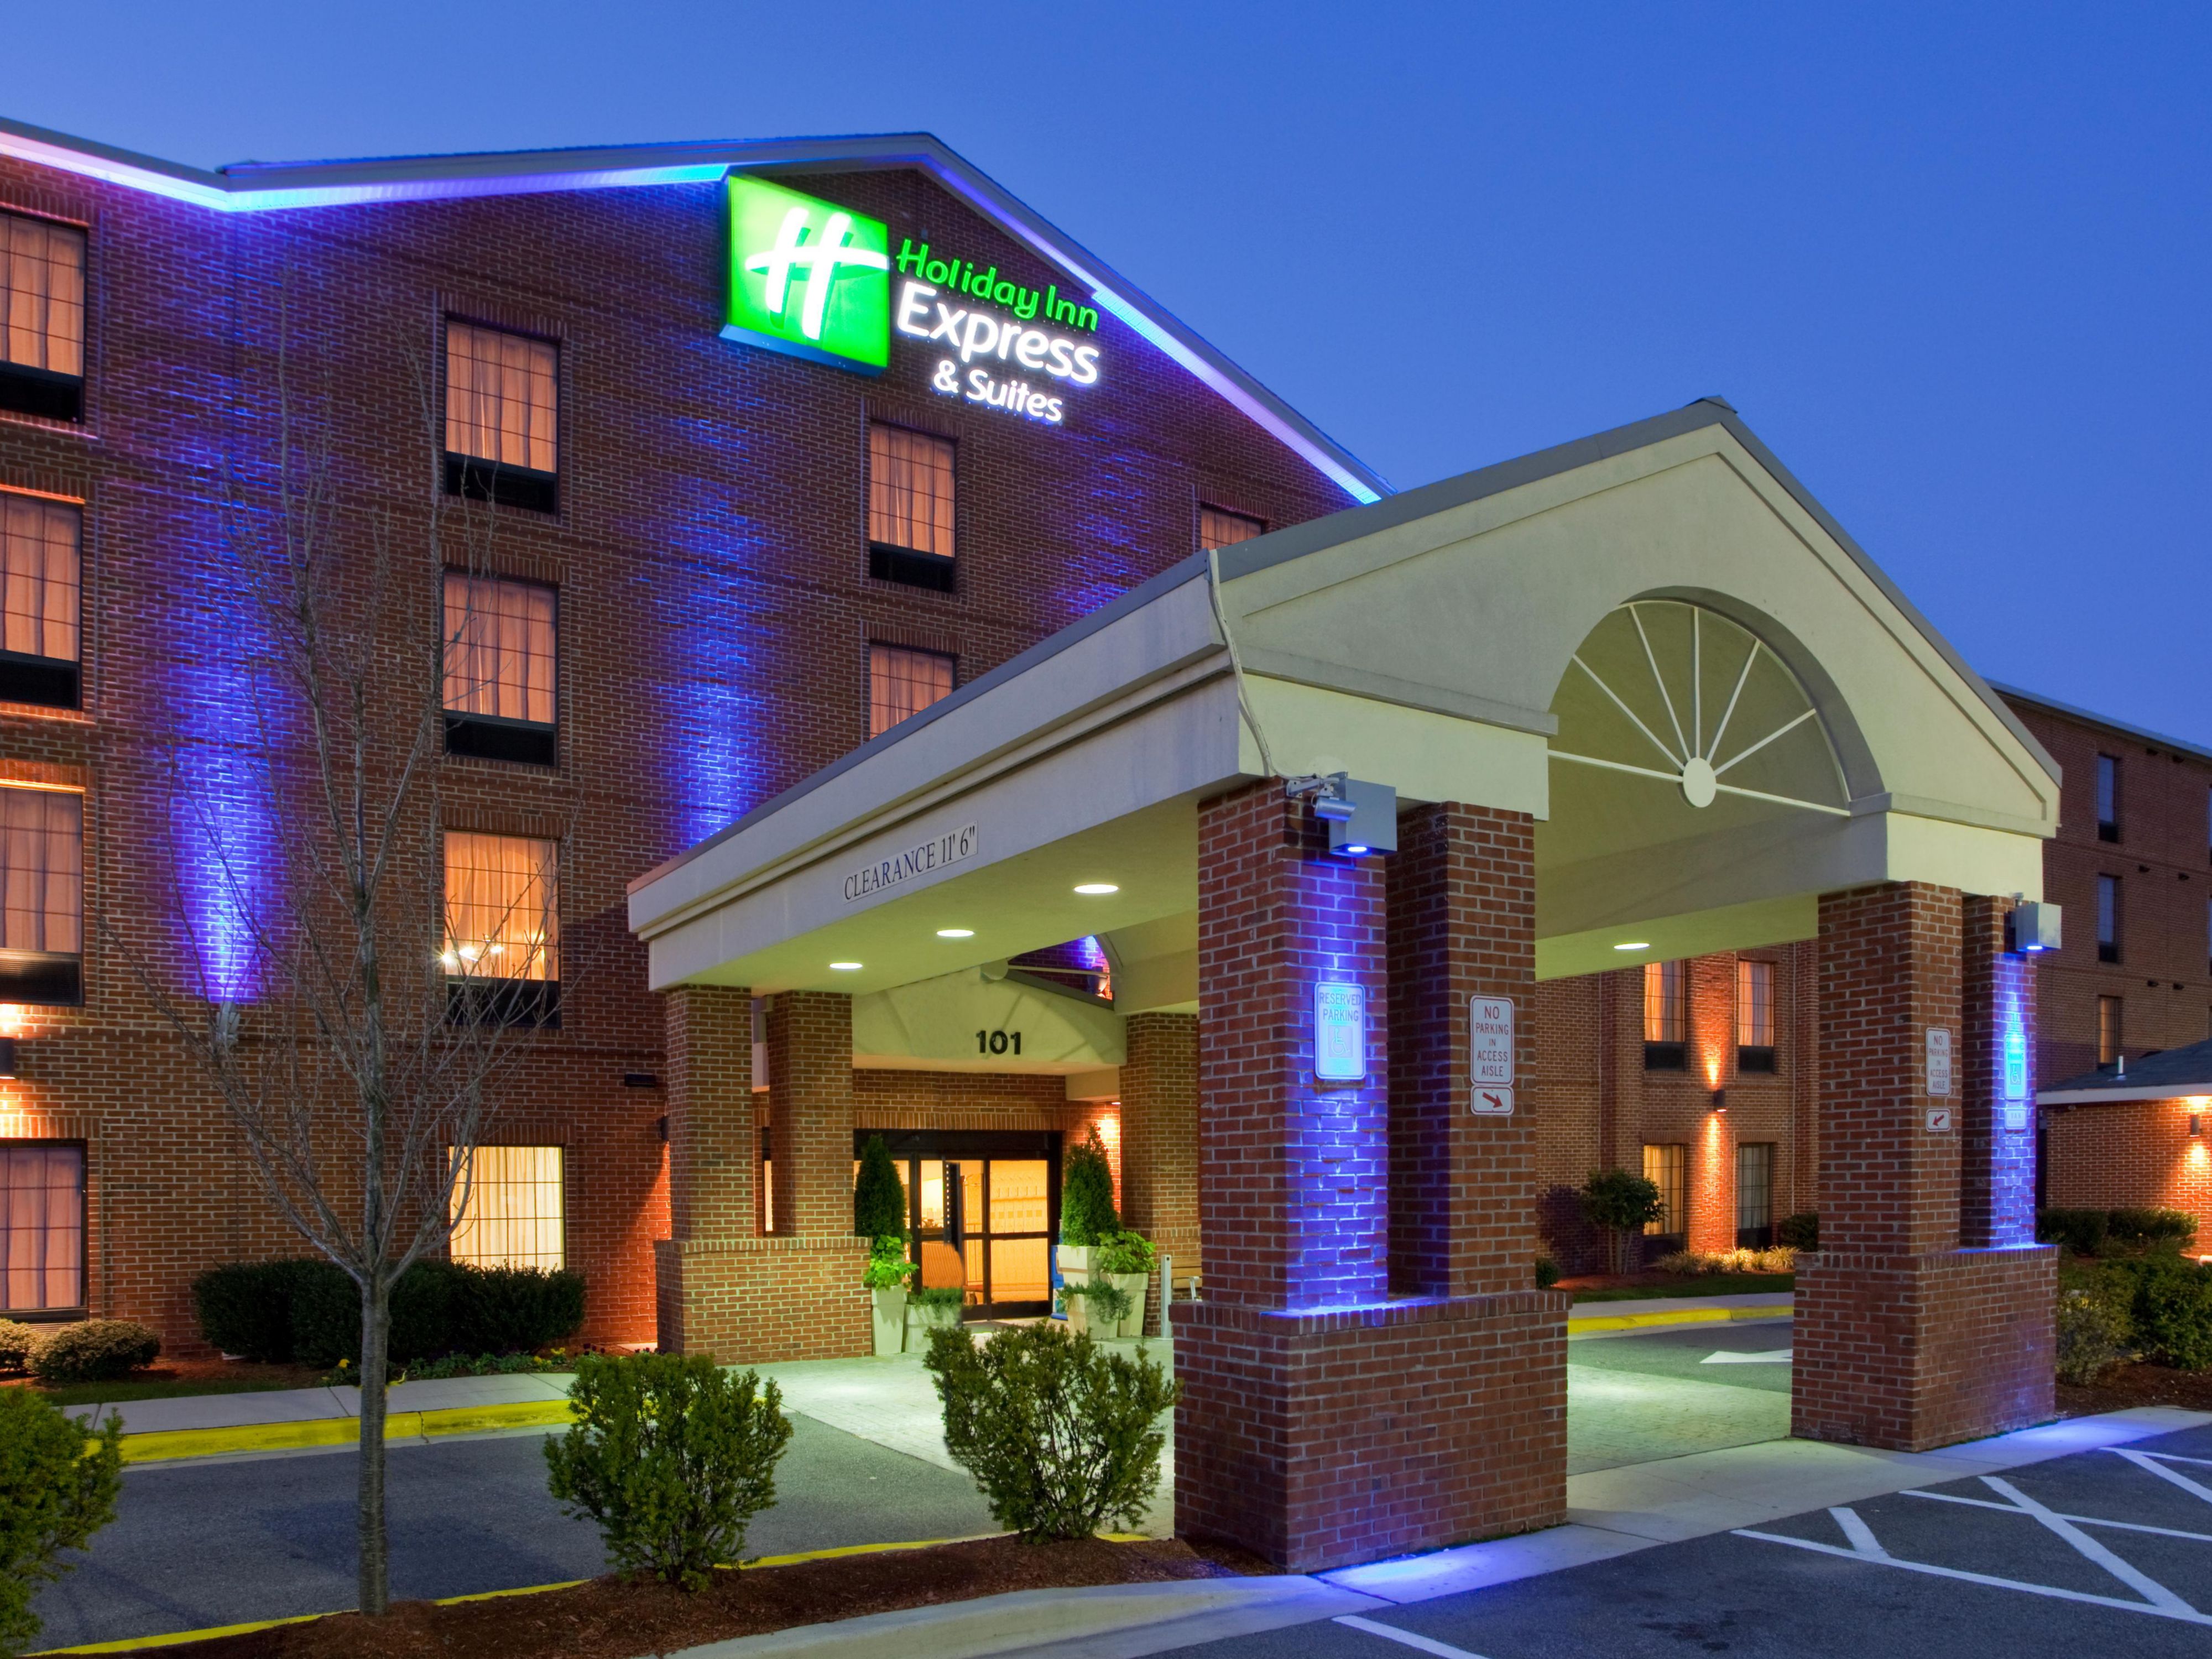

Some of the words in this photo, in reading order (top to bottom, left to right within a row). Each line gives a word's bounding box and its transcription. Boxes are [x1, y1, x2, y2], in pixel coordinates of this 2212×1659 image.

[896, 239, 1039, 319] Holiday
[1046, 285, 1098, 331] Inn
[897, 281, 1100, 385] Express
[933, 361, 958, 393] &
[967, 370, 1063, 422] Suites
[844, 842, 936, 900] CLEARANCE
[1319, 992, 1361, 1005] RESERVED
[1323, 1009, 1359, 1021] PARKING
[1484, 1006, 1500, 1019] NO
[1476, 1022, 1509, 1035] PARKING
[976, 1030, 1021, 1055] 101
[1934, 1035, 1943, 1045] NO
[1477, 1050, 1508, 1062] ACCESS
[1929, 1048, 1948, 1057] PARKING
[1481, 1065, 1504, 1077] AISLE
[1930, 1068, 1948, 1078] ACCESS
[1933, 1081, 1945, 1089] AISLE
